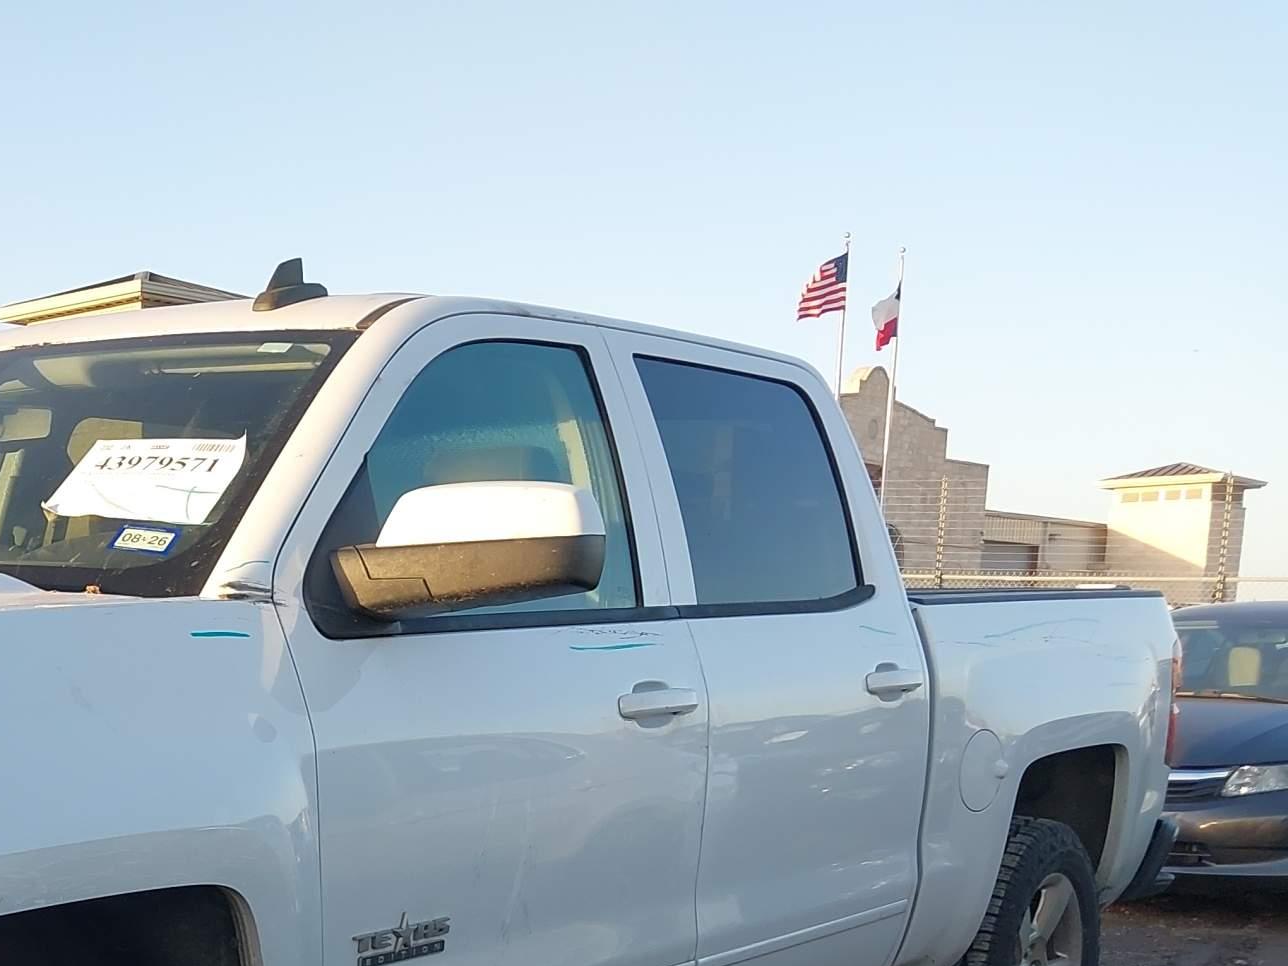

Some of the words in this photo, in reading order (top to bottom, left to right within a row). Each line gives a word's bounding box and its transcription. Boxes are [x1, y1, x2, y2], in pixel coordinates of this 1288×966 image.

[96, 456, 219, 472] 43979571
[122, 532, 142, 544] 08
[147, 535, 169, 546] 26
